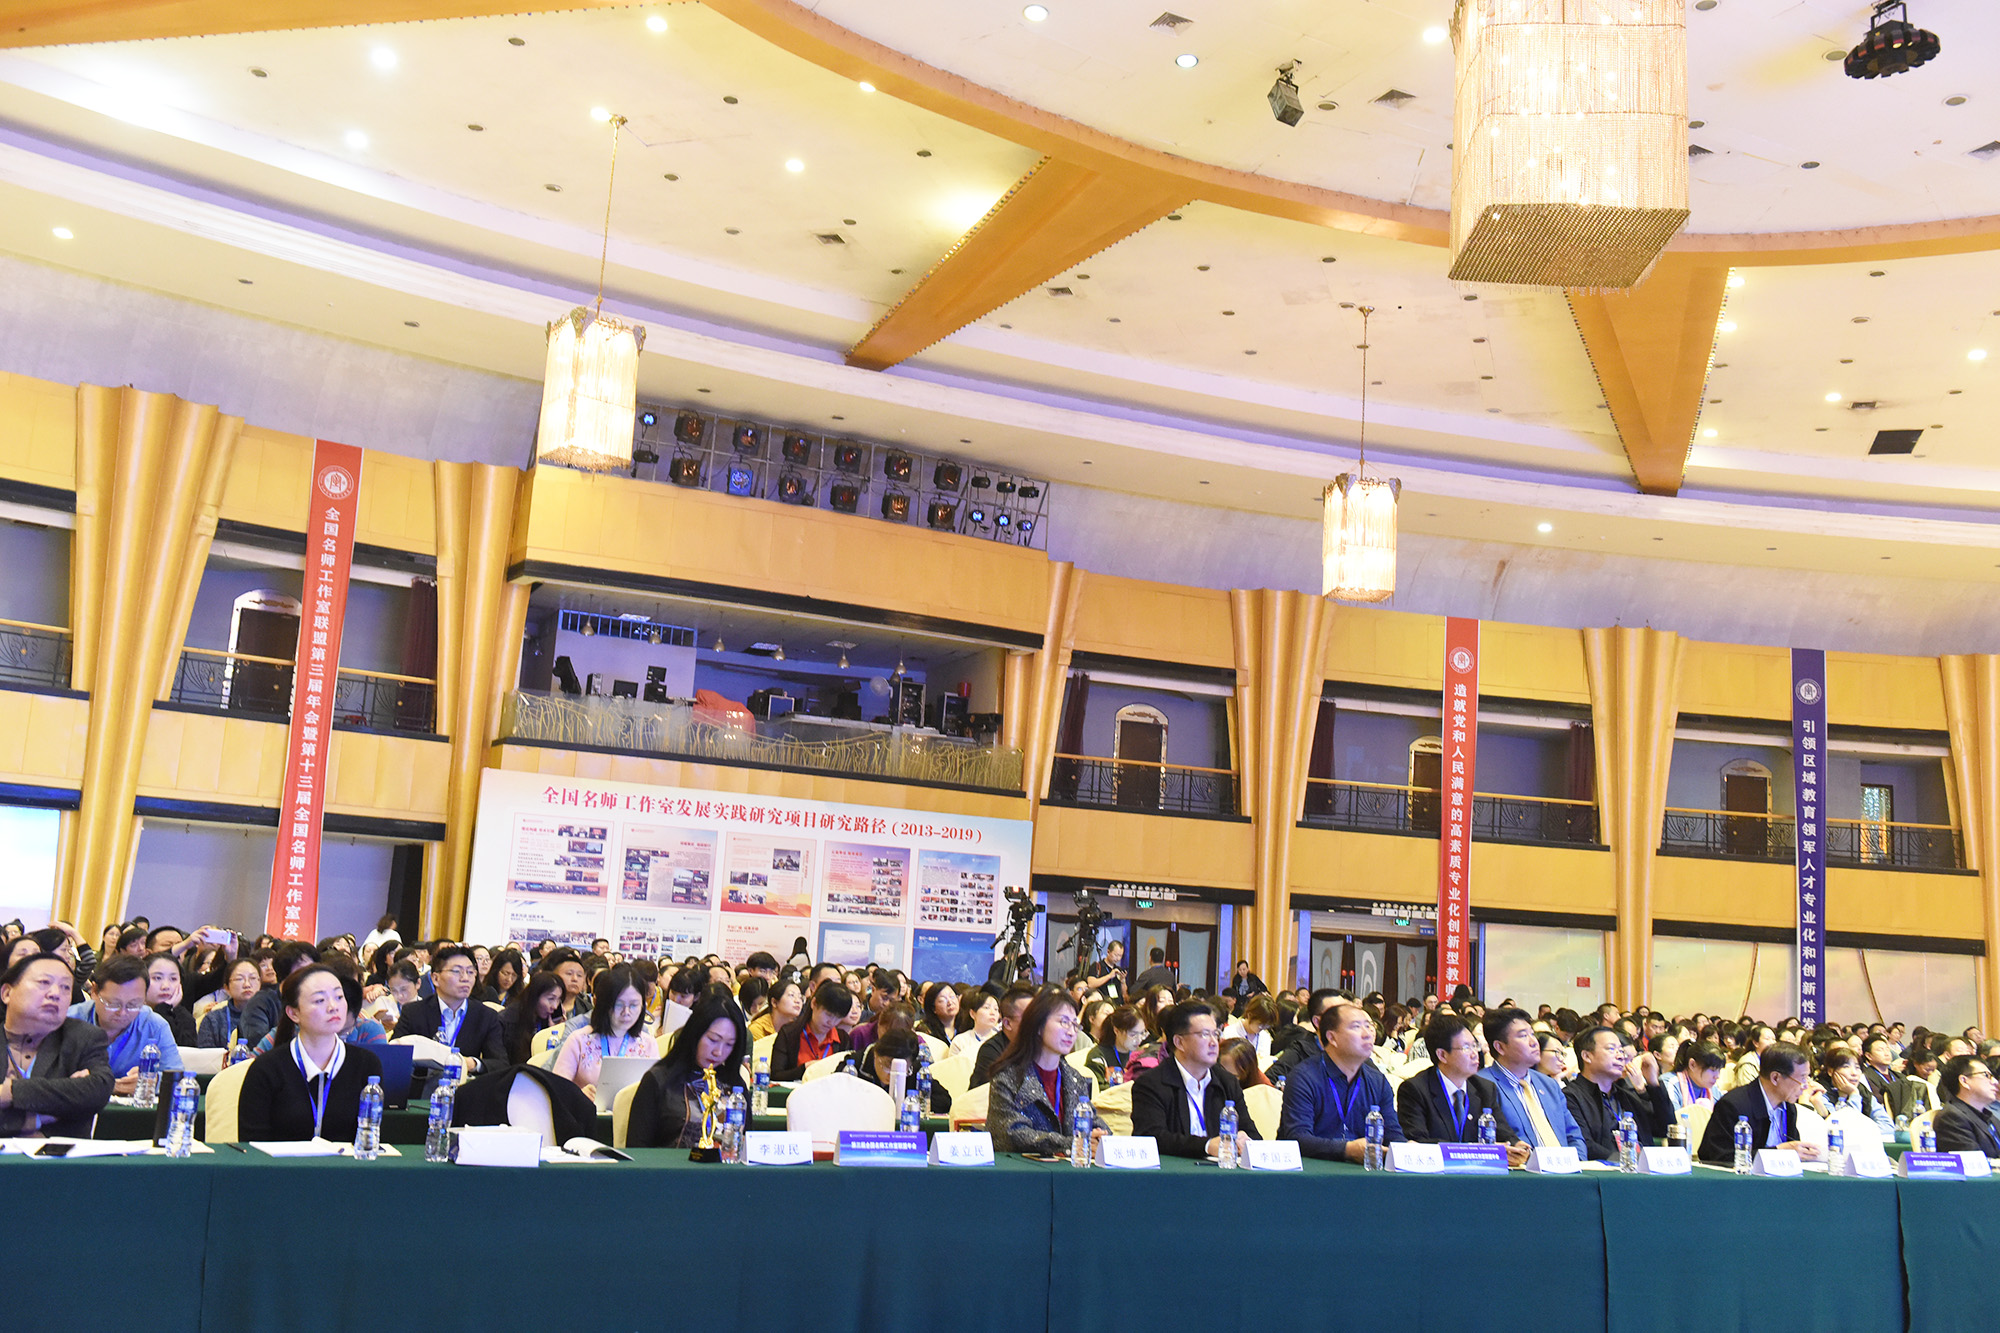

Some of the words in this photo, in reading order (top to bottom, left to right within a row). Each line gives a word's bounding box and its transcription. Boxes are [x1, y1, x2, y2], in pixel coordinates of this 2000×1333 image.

[283, 507, 341, 940] 全国名师工作室联盟第三届年会暨第十三届全国名师工作室发
[1445, 683, 1468, 1003] 造就党和人民满意的高素质专业化创新型教师
